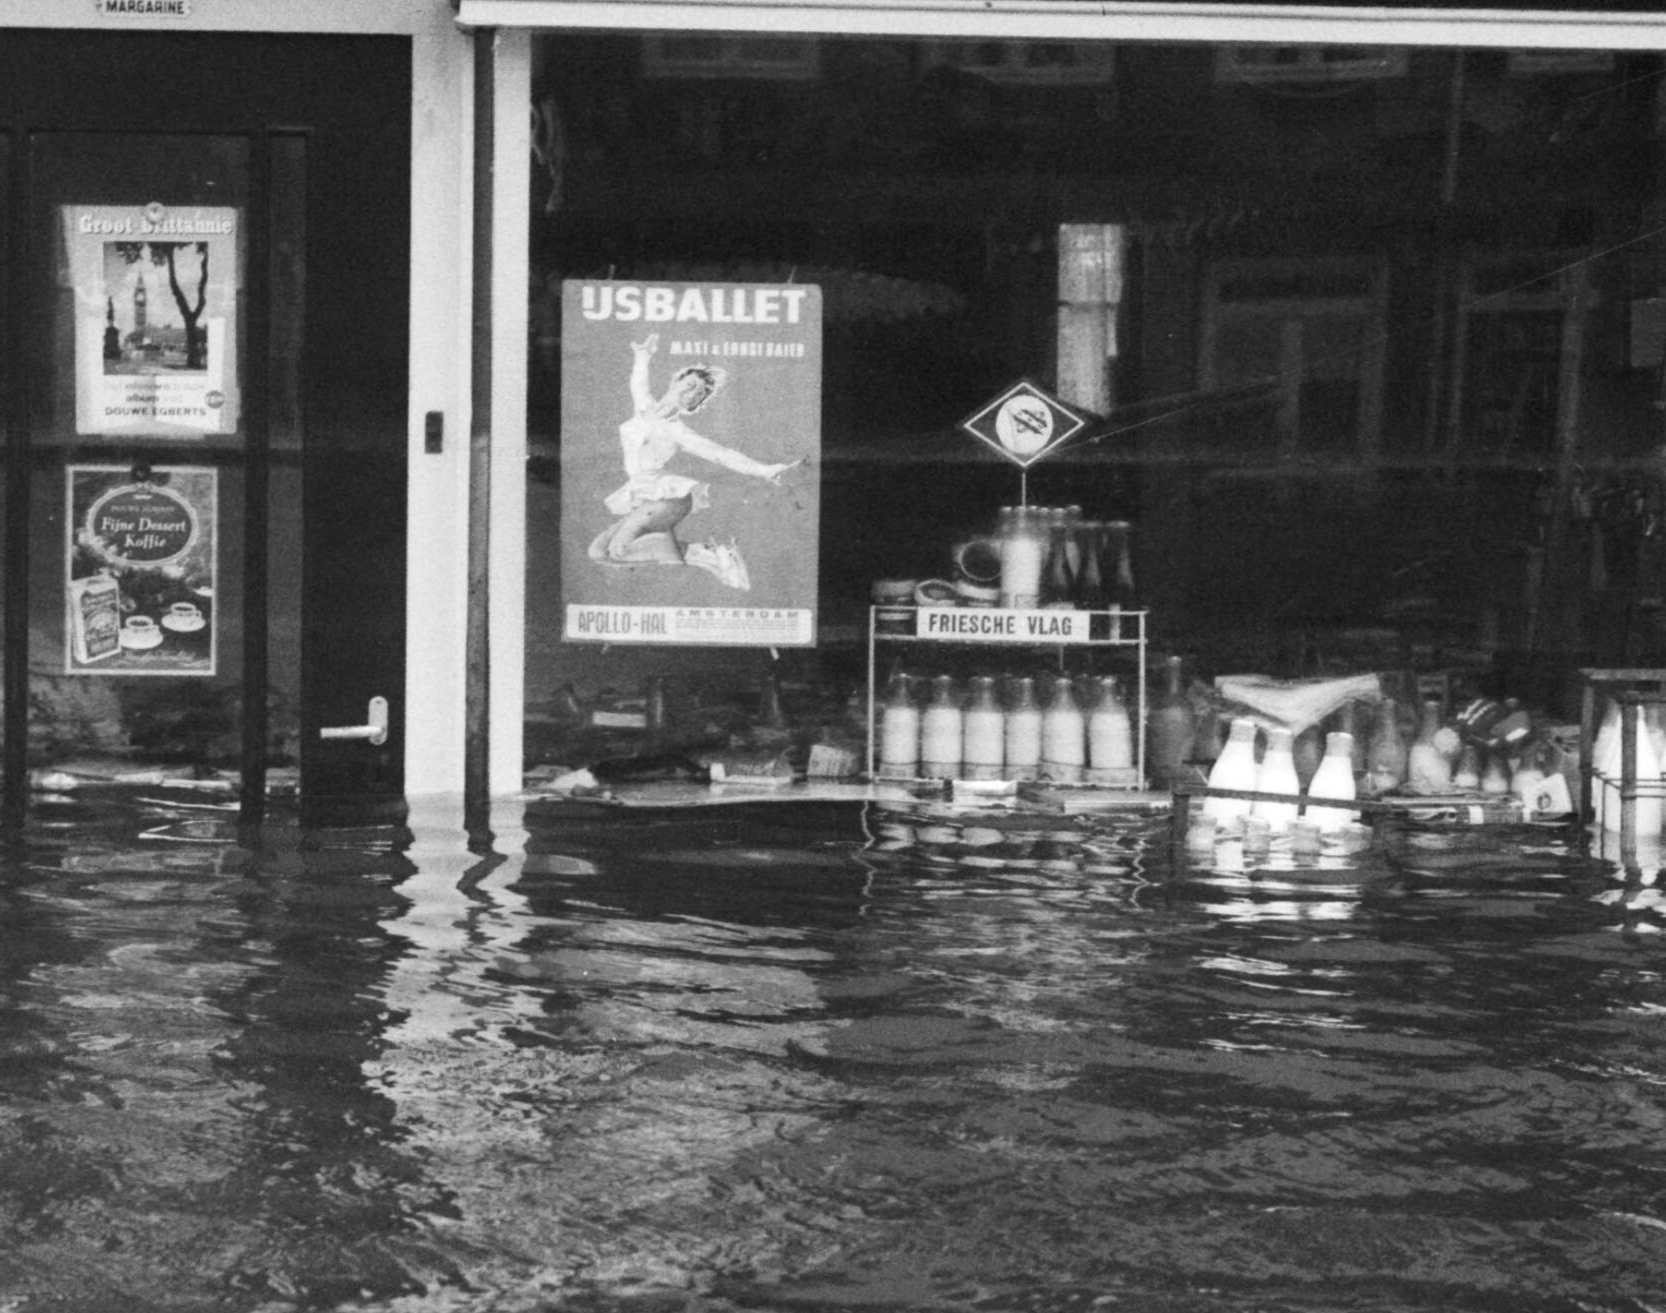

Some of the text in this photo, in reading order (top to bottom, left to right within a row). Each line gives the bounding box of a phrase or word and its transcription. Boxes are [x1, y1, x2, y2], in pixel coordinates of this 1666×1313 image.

[105, 0, 185, 15] MARGARINE
[581, 285, 807, 323] IJSBALLET
[104, 406, 208, 417] DOUWE EGBERTS
[100, 516, 186, 534] Fijne Dessert
[123, 533, 167, 550] Koffie
[577, 609, 669, 636] APOLLO-HAL
[675, 608, 800, 620] AMSTERDAM
[928, 612, 1074, 637] FRIESCHE VLAG
